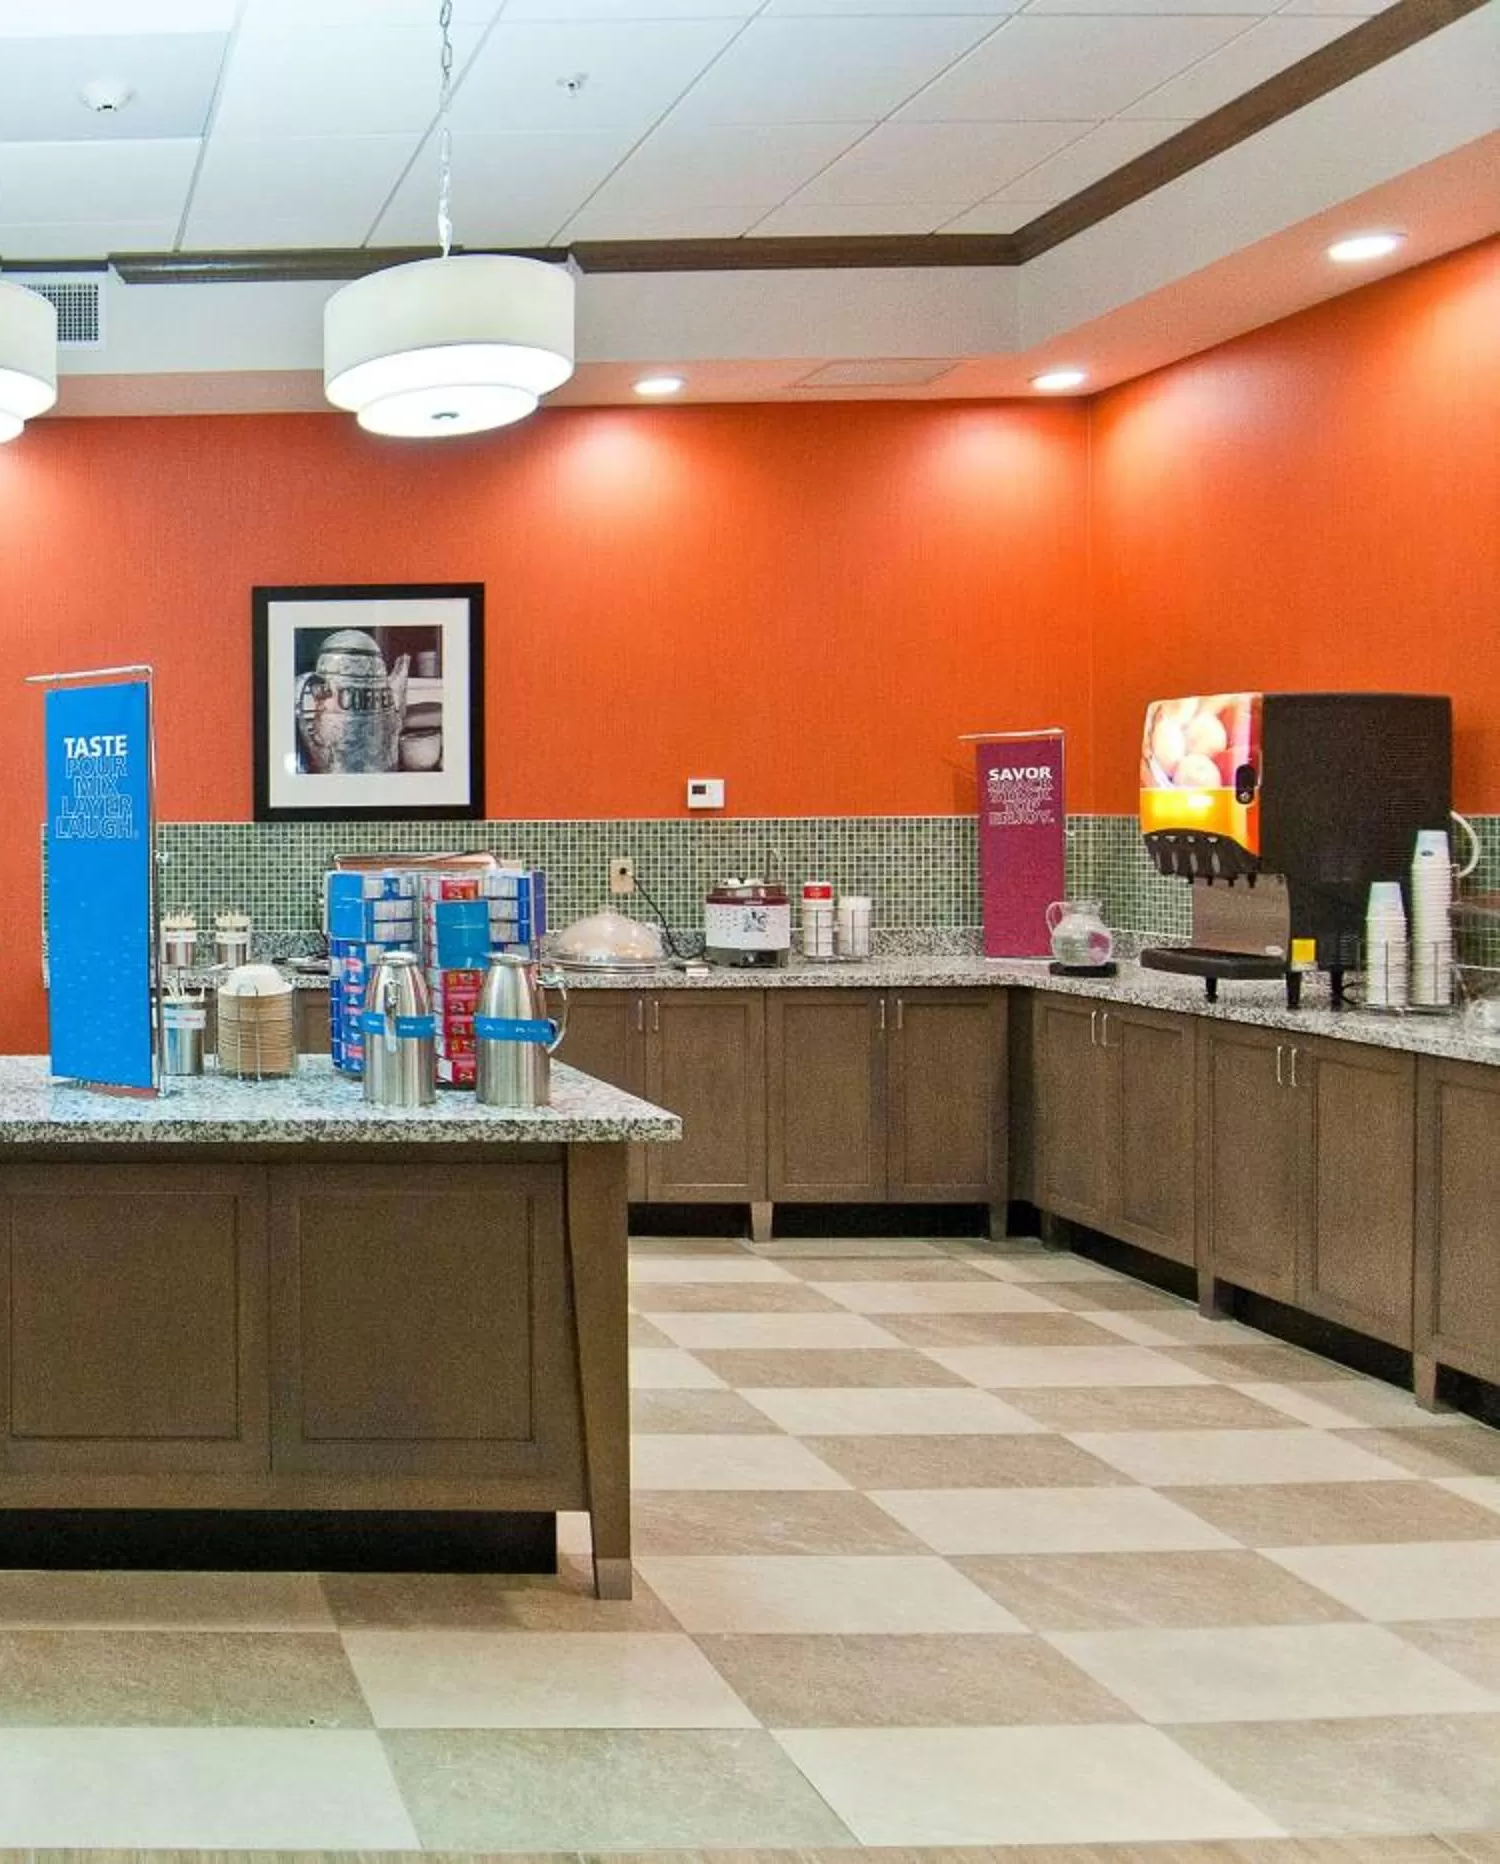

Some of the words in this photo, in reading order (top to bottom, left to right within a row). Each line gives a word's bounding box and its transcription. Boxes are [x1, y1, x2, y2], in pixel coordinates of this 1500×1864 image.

[63, 735, 128, 759] TASTE
[65, 755, 128, 779] POUR
[988, 765, 1053, 781] SAVOR
[73, 775, 120, 798] MIX
[61, 794, 132, 819] LAYER
